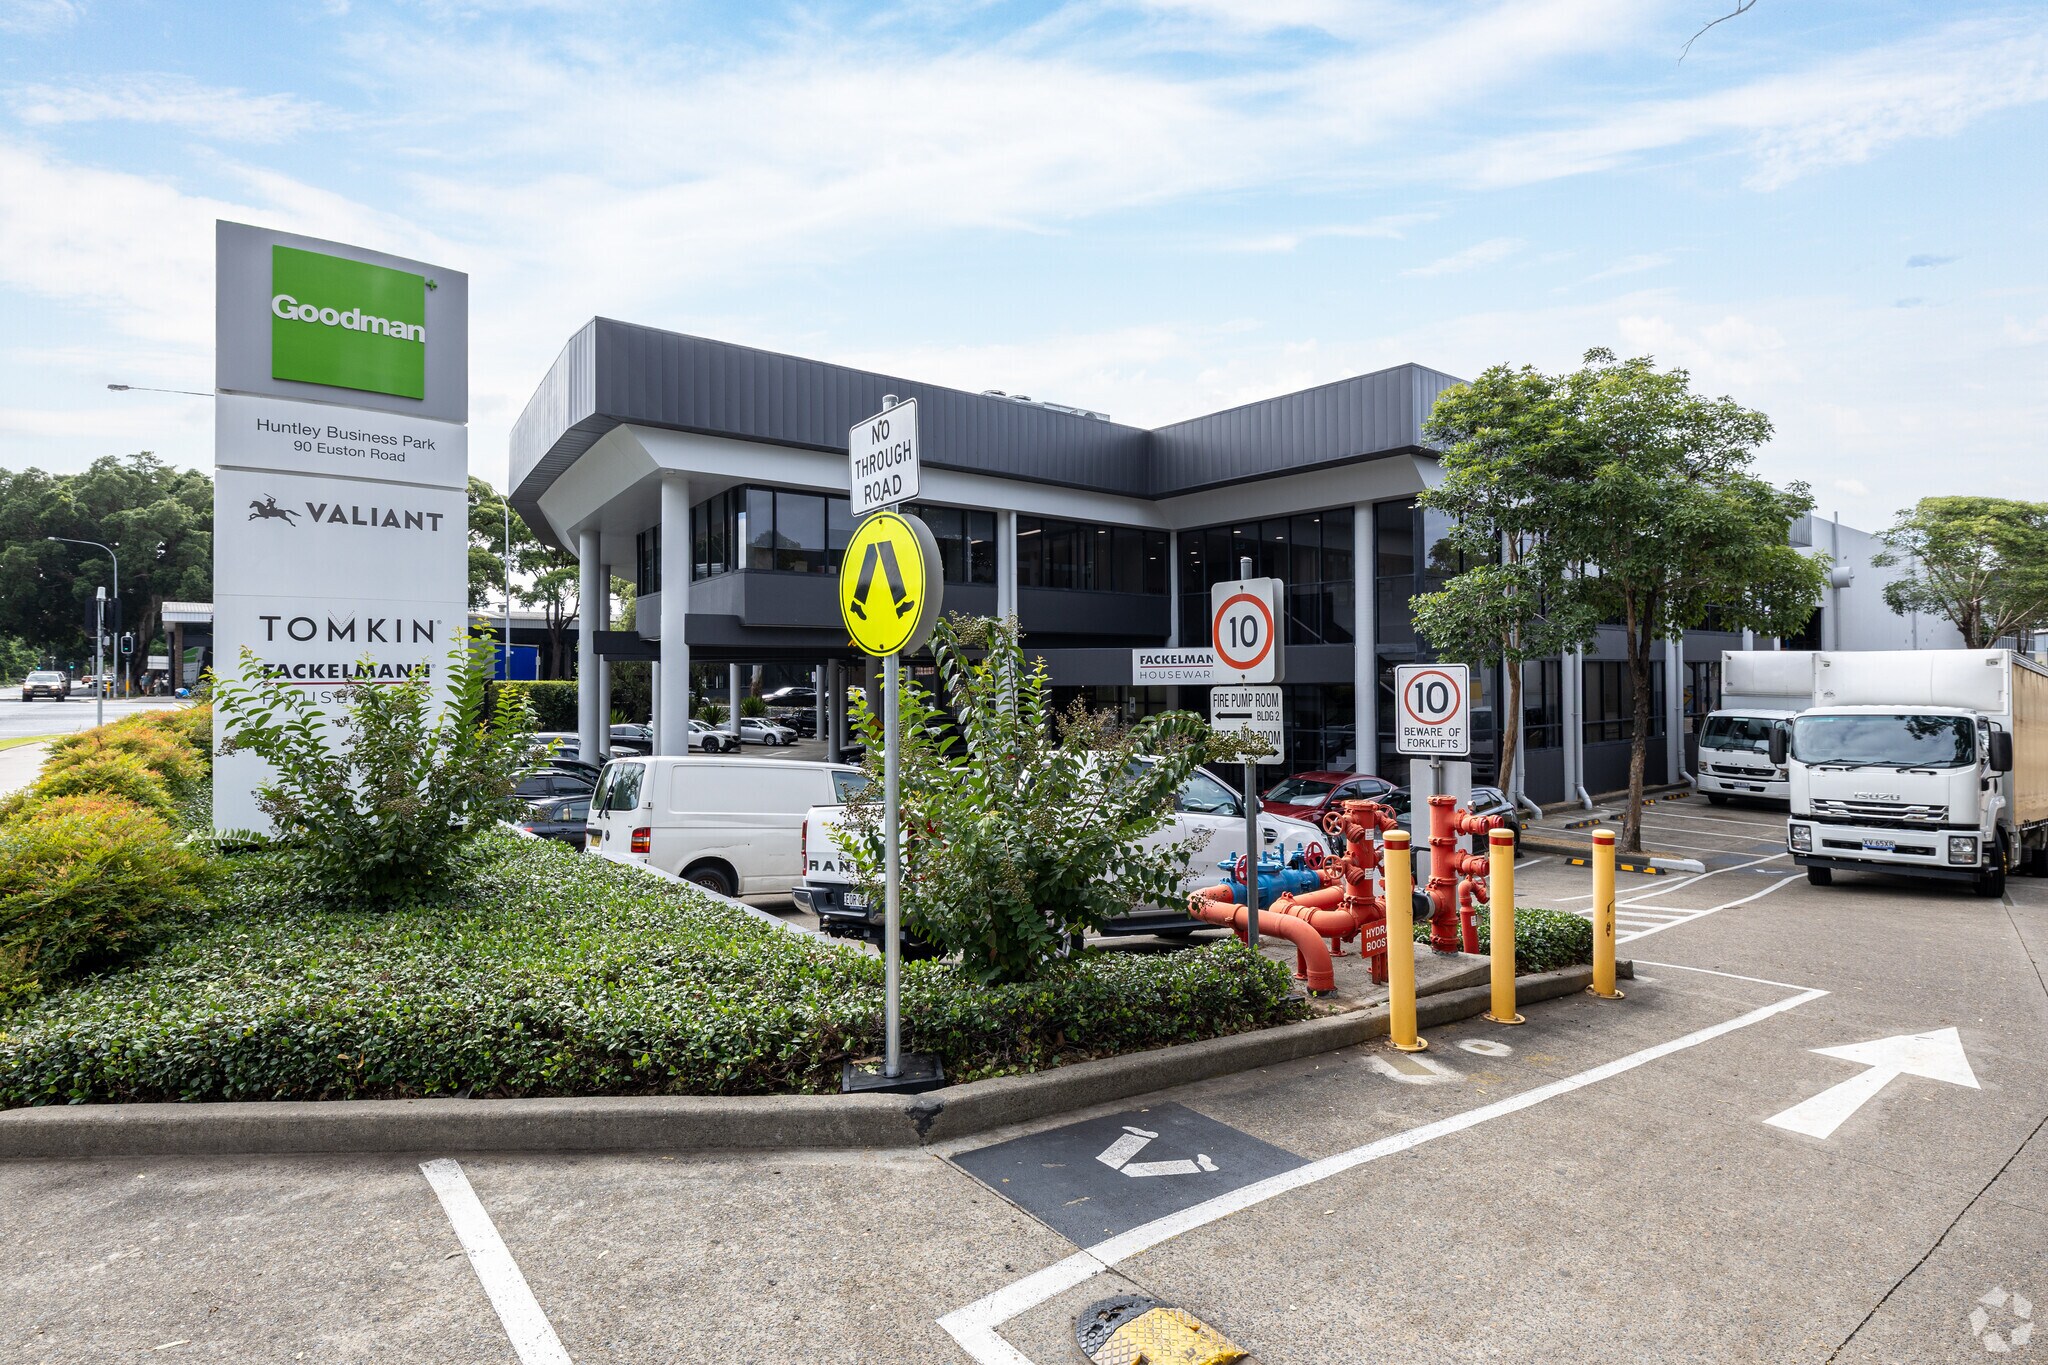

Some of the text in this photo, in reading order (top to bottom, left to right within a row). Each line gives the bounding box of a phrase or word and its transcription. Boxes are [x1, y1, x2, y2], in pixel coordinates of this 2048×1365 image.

[271, 293, 426, 344] Goodman
[257, 418, 436, 451] Huntley Business Park
[871, 419, 890, 445] NO
[293, 441, 406, 463] 90 Euston Road
[854, 438, 912, 480] THROUGH
[864, 474, 903, 504] ROAD
[305, 501, 444, 532] VALIANT
[1229, 614, 1258, 648] 10
[1139, 670, 1214, 679] HOUSEWAR
[1213, 692, 1279, 708] FIRE PUMP ROOM
[1414, 681, 1449, 714] 10
[1256, 710, 1280, 722] BLDG 2
[1404, 726, 1462, 738] BEWARE OF
[1407, 737, 1459, 749] FORKLIFTS
[1854, 791, 1901, 802] ISUZU
[1366, 924, 1388, 939] HYDR
[1366, 936, 1388, 952] BOOS
